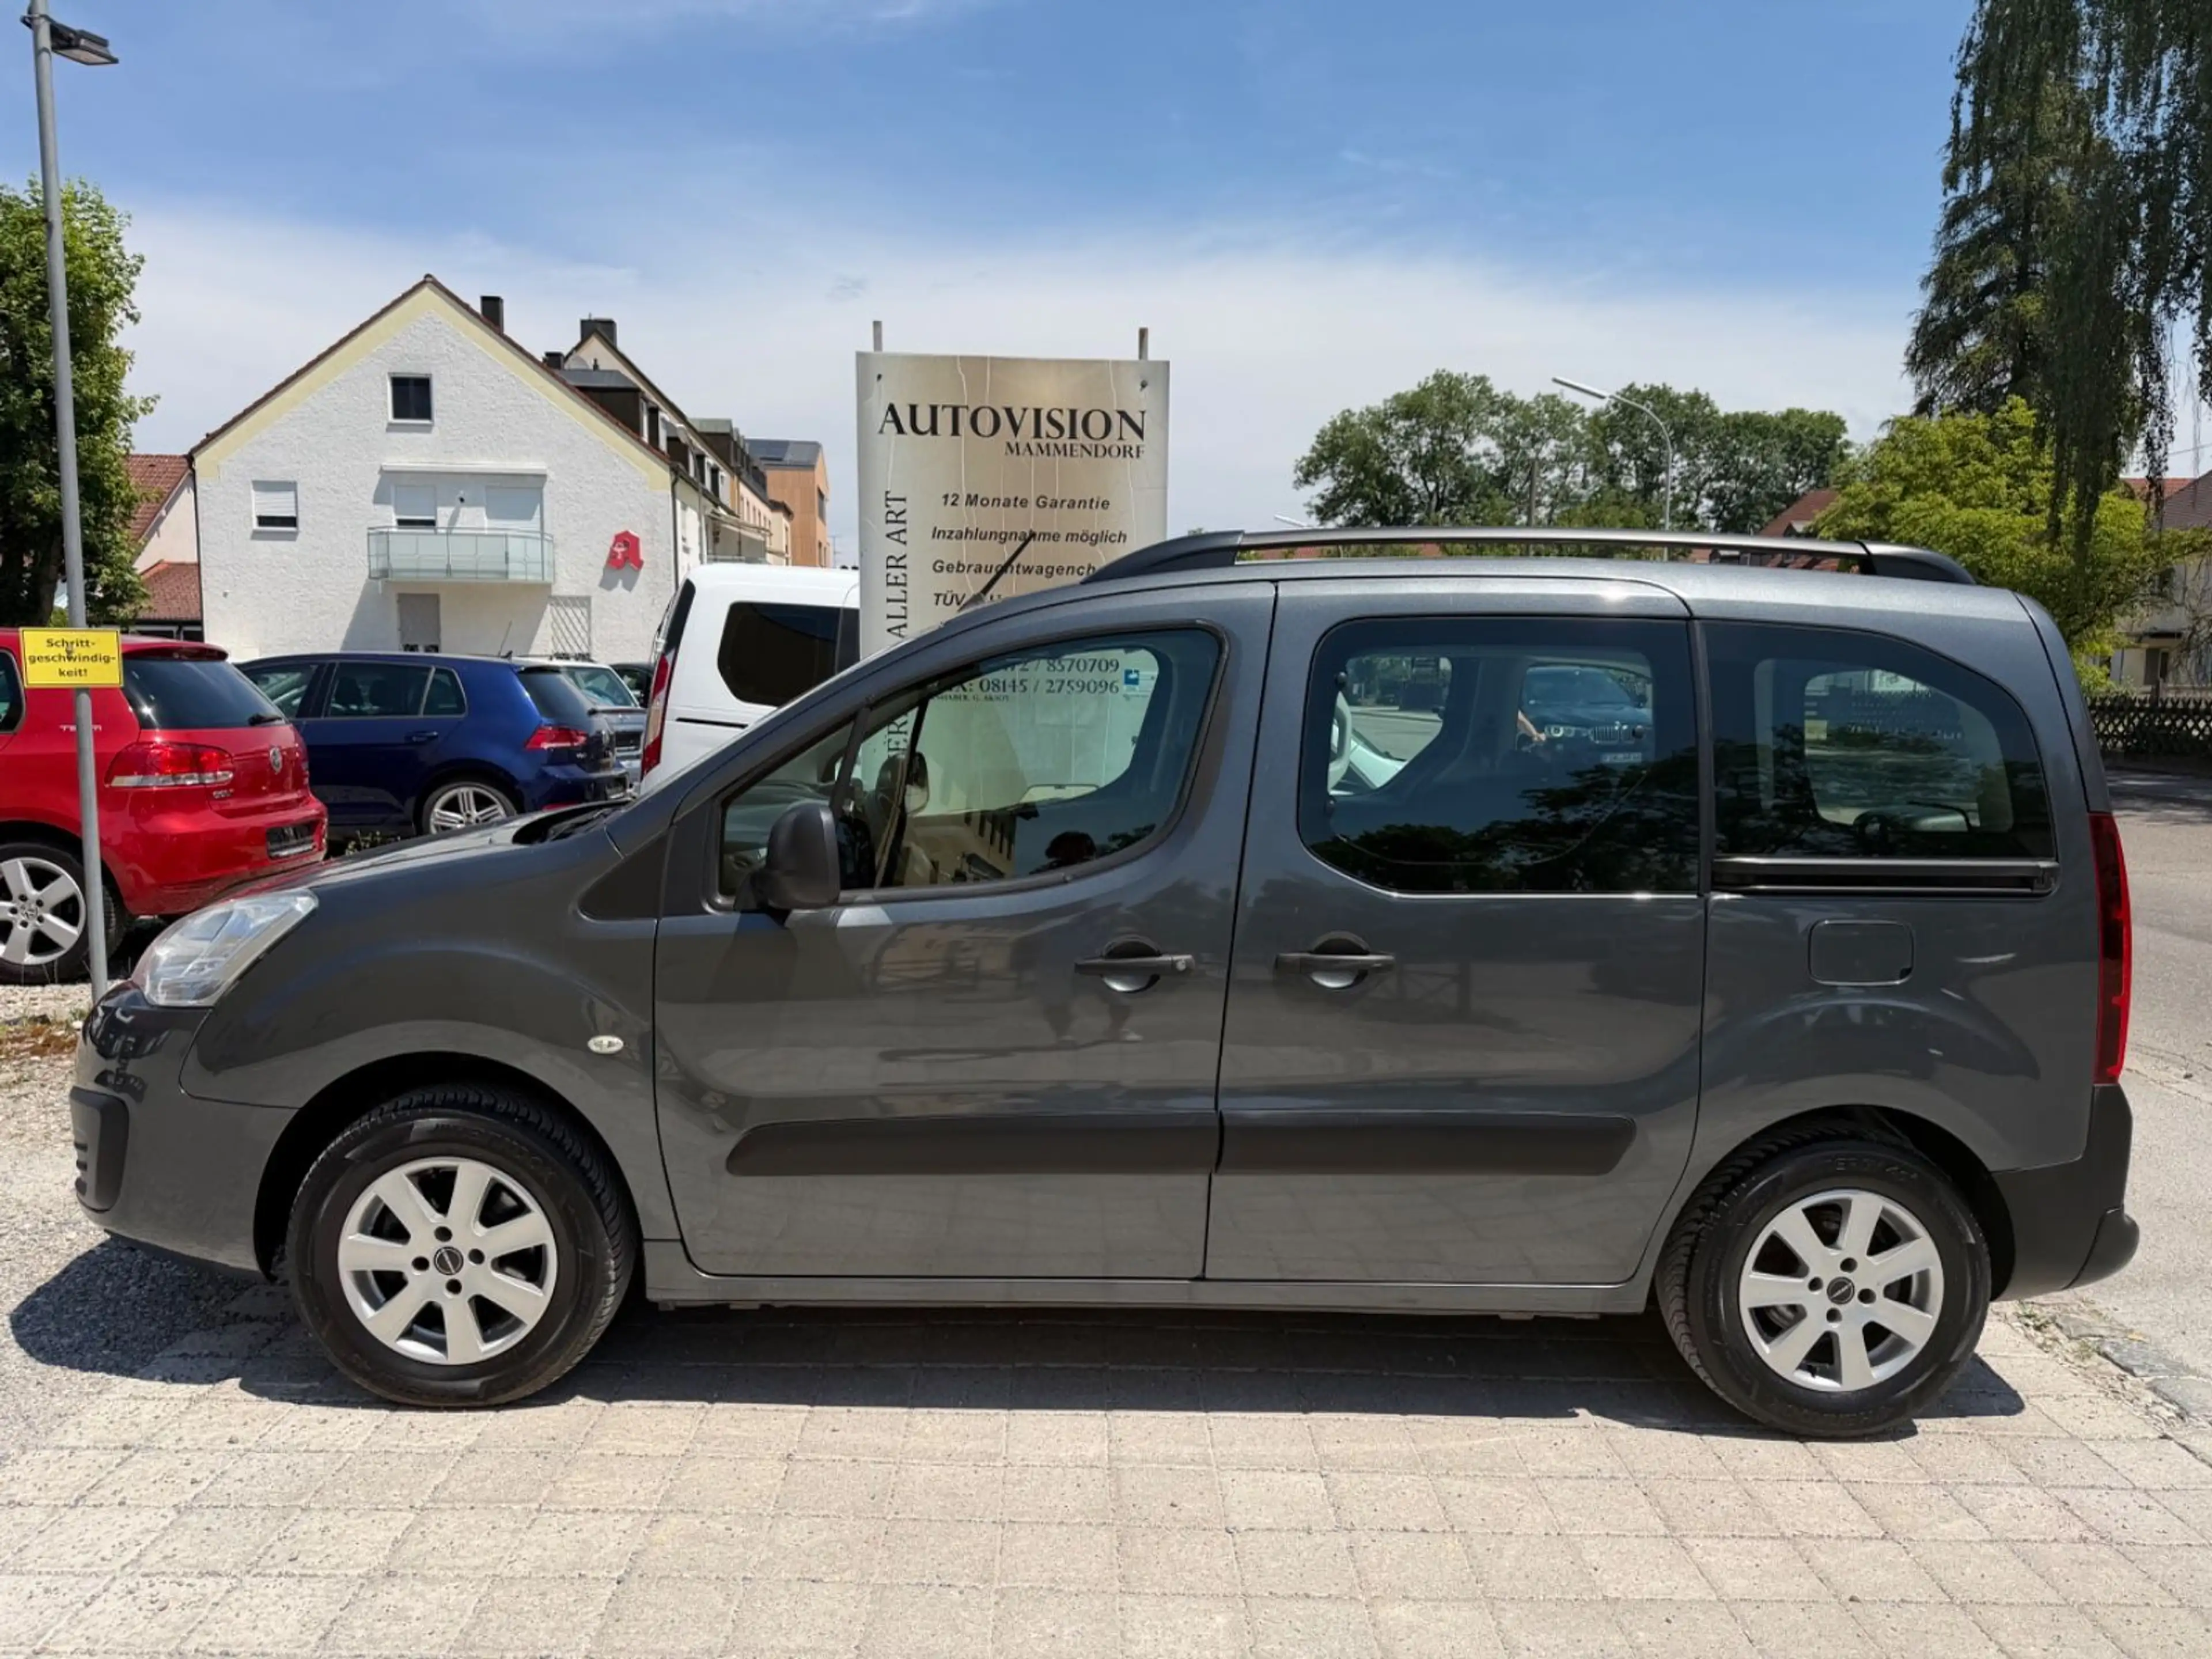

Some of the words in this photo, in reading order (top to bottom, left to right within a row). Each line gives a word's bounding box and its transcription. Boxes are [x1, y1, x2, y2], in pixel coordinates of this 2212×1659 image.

[878, 403, 1146, 441] AUTOVISION
[1005, 441, 1145, 459] MAMMENDORF
[942, 494, 959, 507] 12
[965, 494, 1028, 509] Monate
[1036, 495, 1110, 510] Garantie
[885, 490, 907, 546] ART
[931, 527, 1060, 544] Inzahlungnahme
[1066, 530, 1127, 547] möglich
[933, 560, 1096, 578] Gebrauchtwagench
[887, 554, 907, 638] ALLER
[934, 590, 965, 606] TÜV
[46, 638, 96, 647] Schritt-
[28, 653, 116, 664] geschwindig-
[1046, 658, 1119, 673] 8570709
[58, 668, 88, 677] keit!
[979, 678, 1028, 692] 08145
[1046, 679, 1119, 694] 2759096
